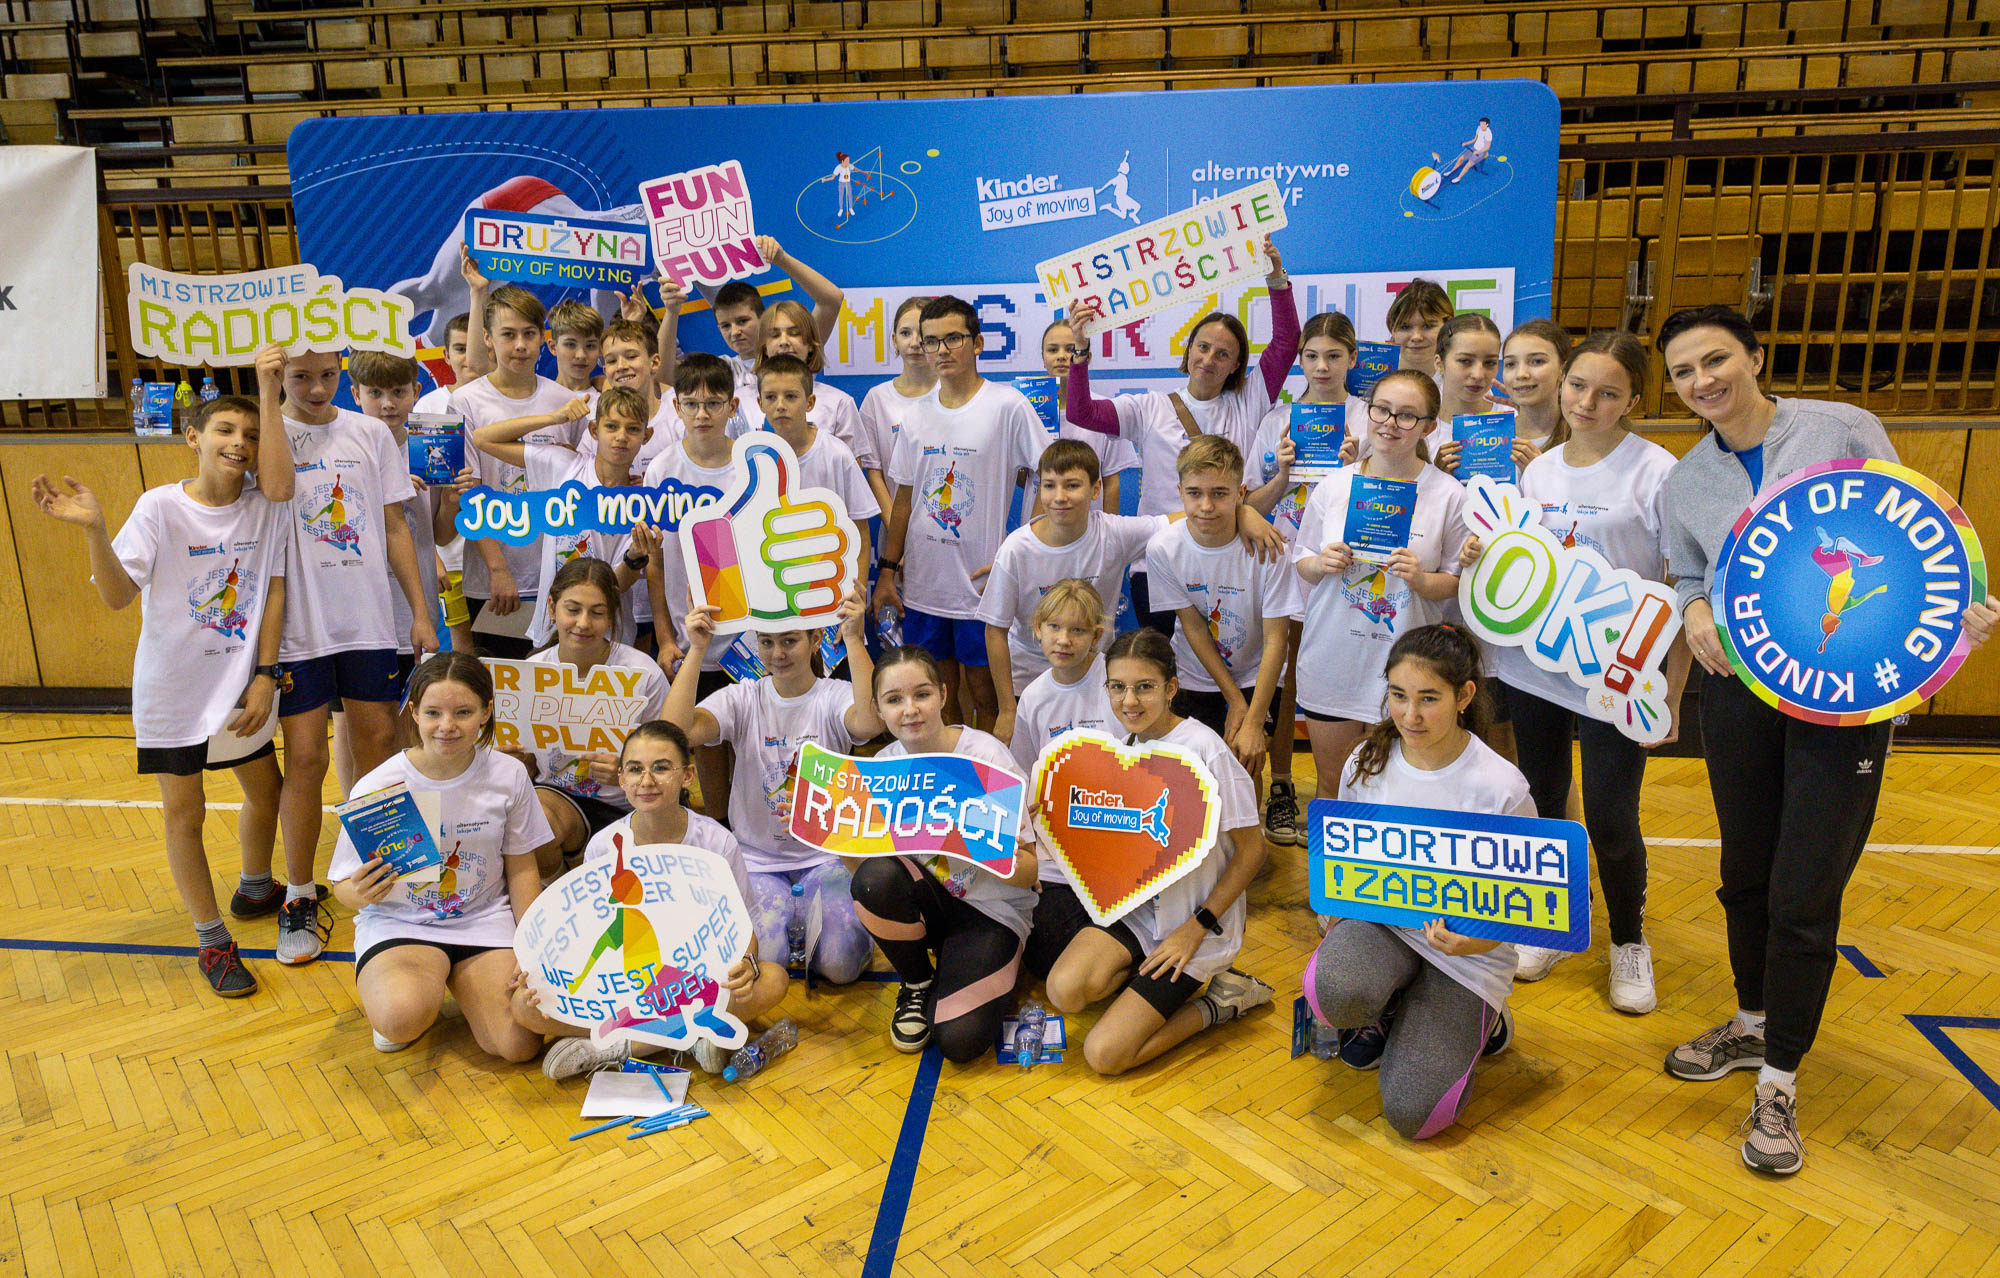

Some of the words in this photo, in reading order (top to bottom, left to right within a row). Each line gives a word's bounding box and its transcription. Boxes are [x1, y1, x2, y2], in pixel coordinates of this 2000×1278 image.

[645, 166, 744, 219] FUN
[976, 173, 1059, 201] Kinder
[1191, 159, 1350, 184] alternatywne
[655, 200, 750, 257] FUN
[985, 206, 1013, 224] Joy
[1017, 201, 1033, 218] of
[1037, 194, 1090, 216] moving
[478, 220, 641, 262] DRUŻYNA
[1046, 193, 1275, 297] MISTRZOWIE
[487, 256, 524, 273] JOY
[529, 261, 553, 276] OF
[558, 264, 632, 284] MOVING
[661, 237, 764, 289] FUN
[140, 272, 306, 304] MISTRZOWIE
[138, 283, 404, 356] RADOŚCI
[1297, 423, 1340, 433] DYPLOM
[1459, 436, 1509, 448] DYPLOM
[462, 492, 530, 538] Joy
[544, 487, 582, 527] of
[1355, 500, 1407, 517] DYPLOM
[1807, 478, 1865, 516] OF
[1738, 499, 1794, 580] JOY
[1873, 484, 1961, 663] MOVING
[1733, 592, 1854, 703] KINDER
[534, 666, 643, 698] PLAY
[530, 695, 644, 727] PLAY
[813, 759, 937, 793] MISTRZOWIE
[1070, 786, 1122, 807] Kinder
[803, 780, 1009, 853] RADOŚCI
[1072, 811, 1090, 824] Joy
[1091, 811, 1103, 823] of
[1103, 812, 1138, 828] moving
[1325, 821, 1566, 879] SPORTOWA
[523, 908, 548, 950] WF
[560, 863, 612, 913] JEST
[629, 854, 712, 881] SUPER
[541, 962, 577, 990] WF
[596, 962, 659, 995] JEST
[672, 894, 733, 972] SUPER
[556, 994, 618, 1021] JEST
[634, 962, 714, 1017] SUPER
[717, 921, 739, 964] WF
